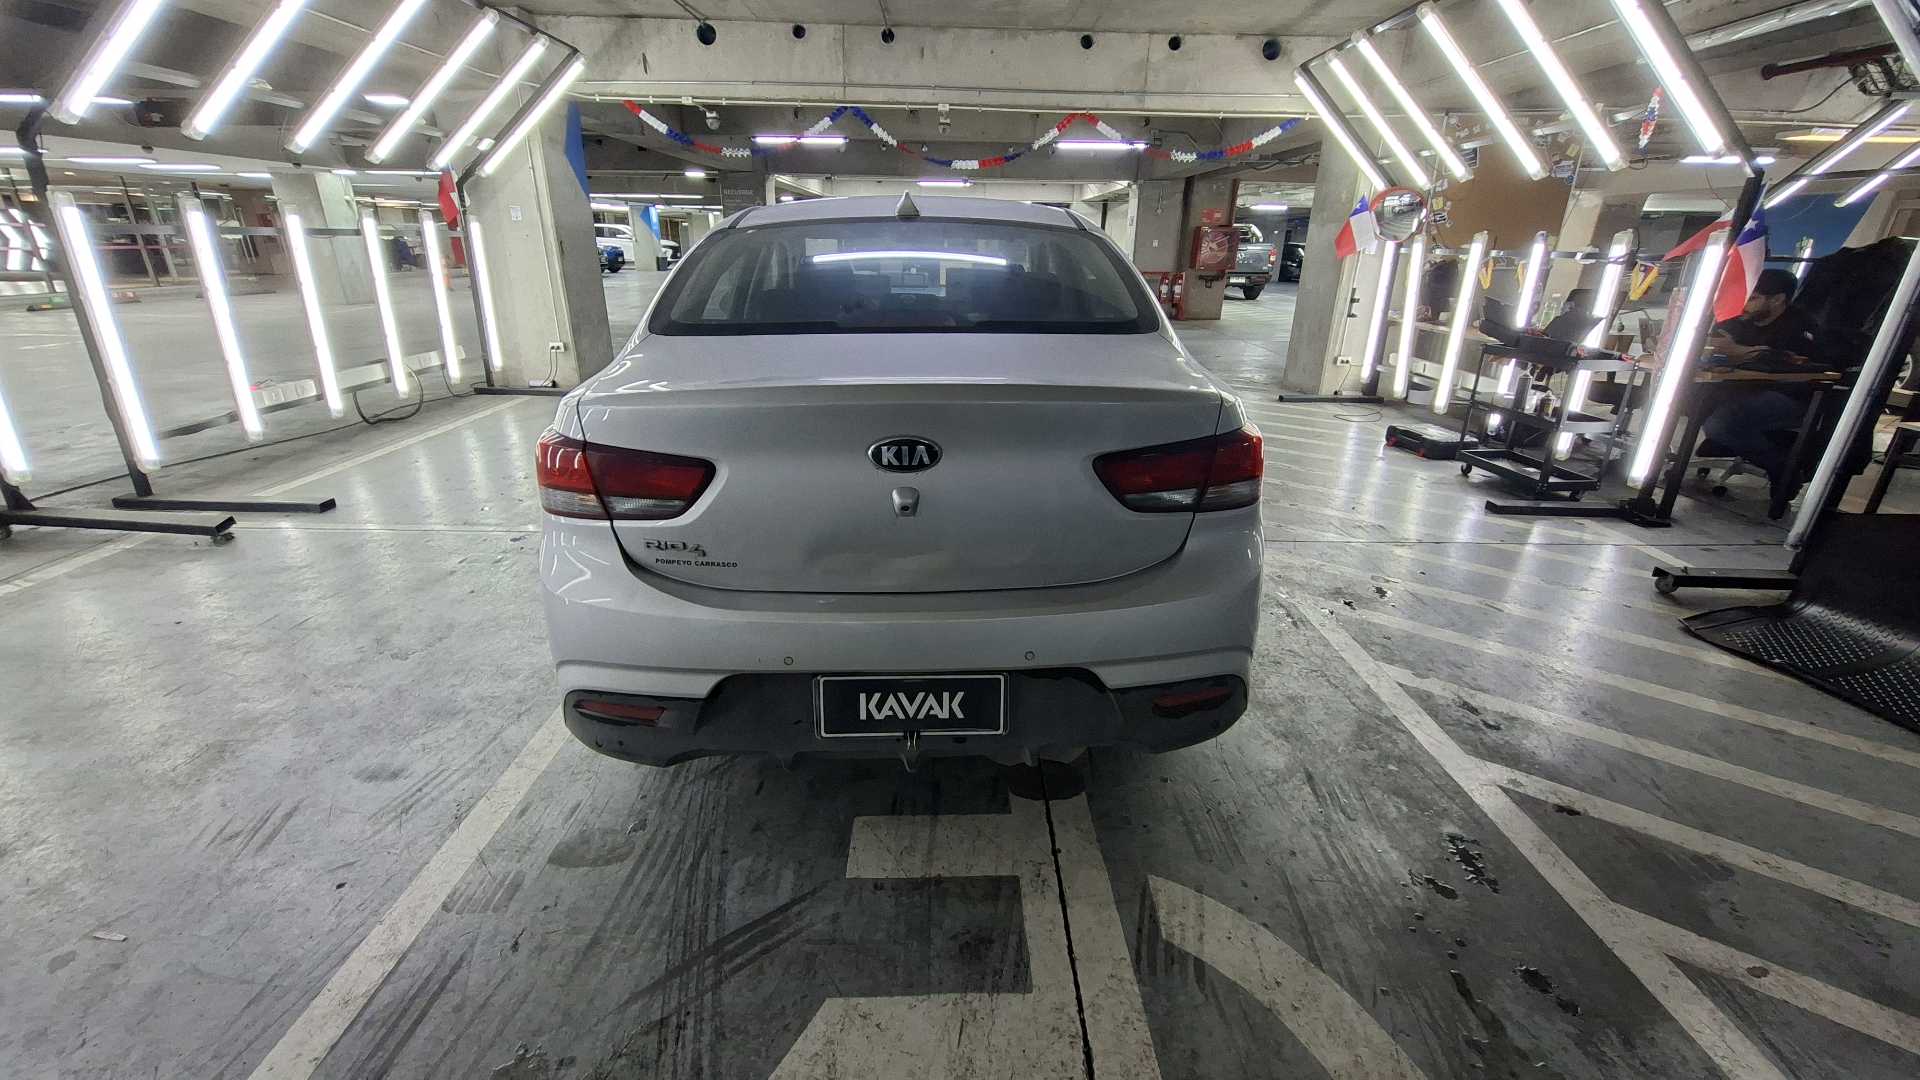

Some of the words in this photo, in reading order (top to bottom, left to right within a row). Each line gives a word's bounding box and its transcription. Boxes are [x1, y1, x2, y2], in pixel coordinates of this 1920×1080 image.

[881, 445, 931, 466] KIA
[655, 558, 692, 567] POMPEYO
[694, 560, 738, 568] CARRASCO
[859, 691, 965, 721] KAVAK
